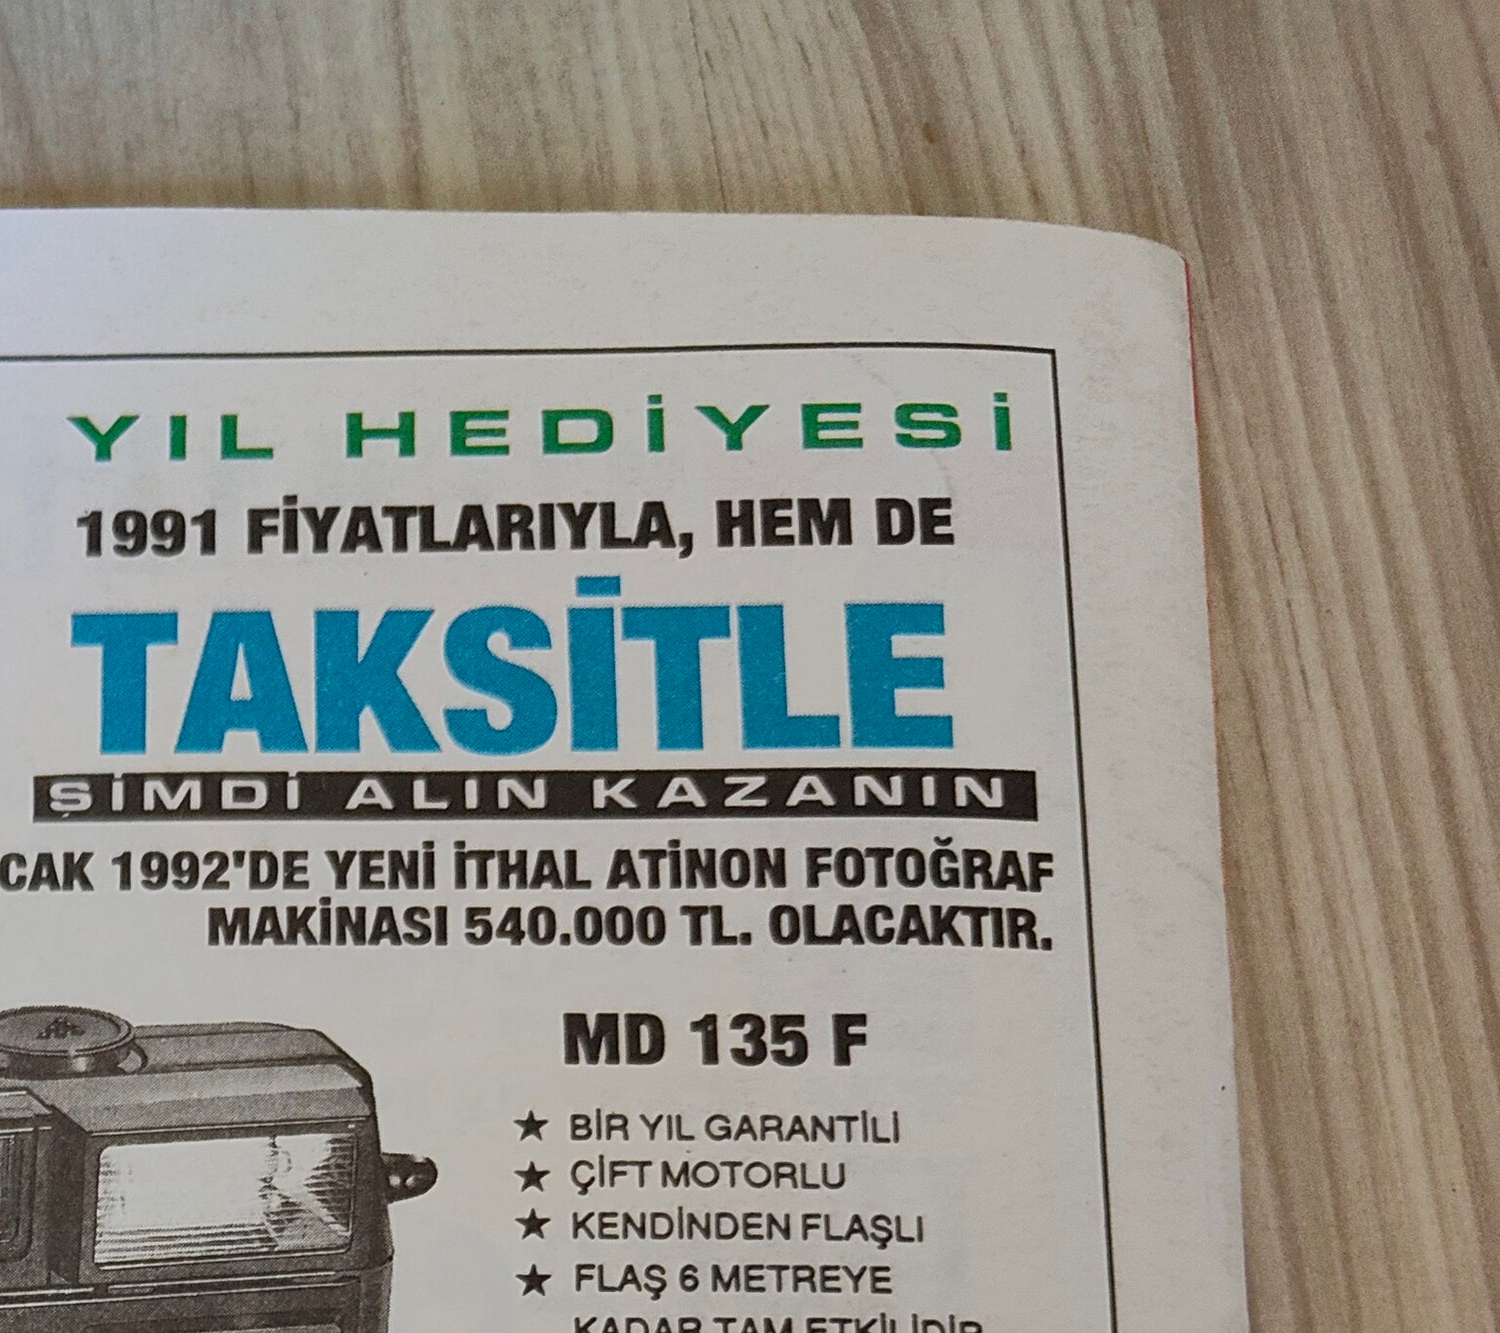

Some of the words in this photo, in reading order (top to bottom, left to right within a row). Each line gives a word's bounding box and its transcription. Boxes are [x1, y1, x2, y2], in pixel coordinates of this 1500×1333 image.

[68, 414, 274, 461] YIL
[347, 393, 1013, 457] HEDİYESİ
[77, 508, 217, 557] 1991
[247, 494, 694, 559] FİYATLARIYLA,
[715, 497, 853, 548] HEM
[875, 497, 955, 546] DE
[72, 575, 953, 755] TAKSİTLE
[48, 770, 300, 818] ŞİMDİ
[346, 776, 548, 810] ALIN
[593, 775, 1007, 809] KAZANIN
[111, 849, 310, 891] 1992'DE
[324, 840, 436, 890] YENİ
[453, 840, 592, 890] İTHAL
[606, 838, 787, 890] ATİNON
[805, 836, 1054, 893] FOTOĞRAF
[208, 896, 448, 946] MAKİNASI
[464, 905, 667, 946] 540.000
[680, 904, 752, 946] TL.
[769, 903, 1053, 951] OLACAKTIR.
[563, 1012, 666, 1065] MD
[690, 1013, 809, 1067] 135
[831, 1013, 868, 1067] F
[570, 1107, 630, 1141] BİR
[639, 1113, 696, 1142] YIL
[704, 1109, 900, 1144] GARANTİLİ
[570, 1154, 653, 1196] ÇİFT
[661, 1160, 846, 1190] MOTORLU
[572, 1205, 791, 1241] KENDİNDEN
[801, 1212, 924, 1251] FLAŞLI
[575, 1263, 668, 1301] FLAŞ
[679, 1263, 700, 1293] 6
[711, 1264, 893, 1295] METREYE
